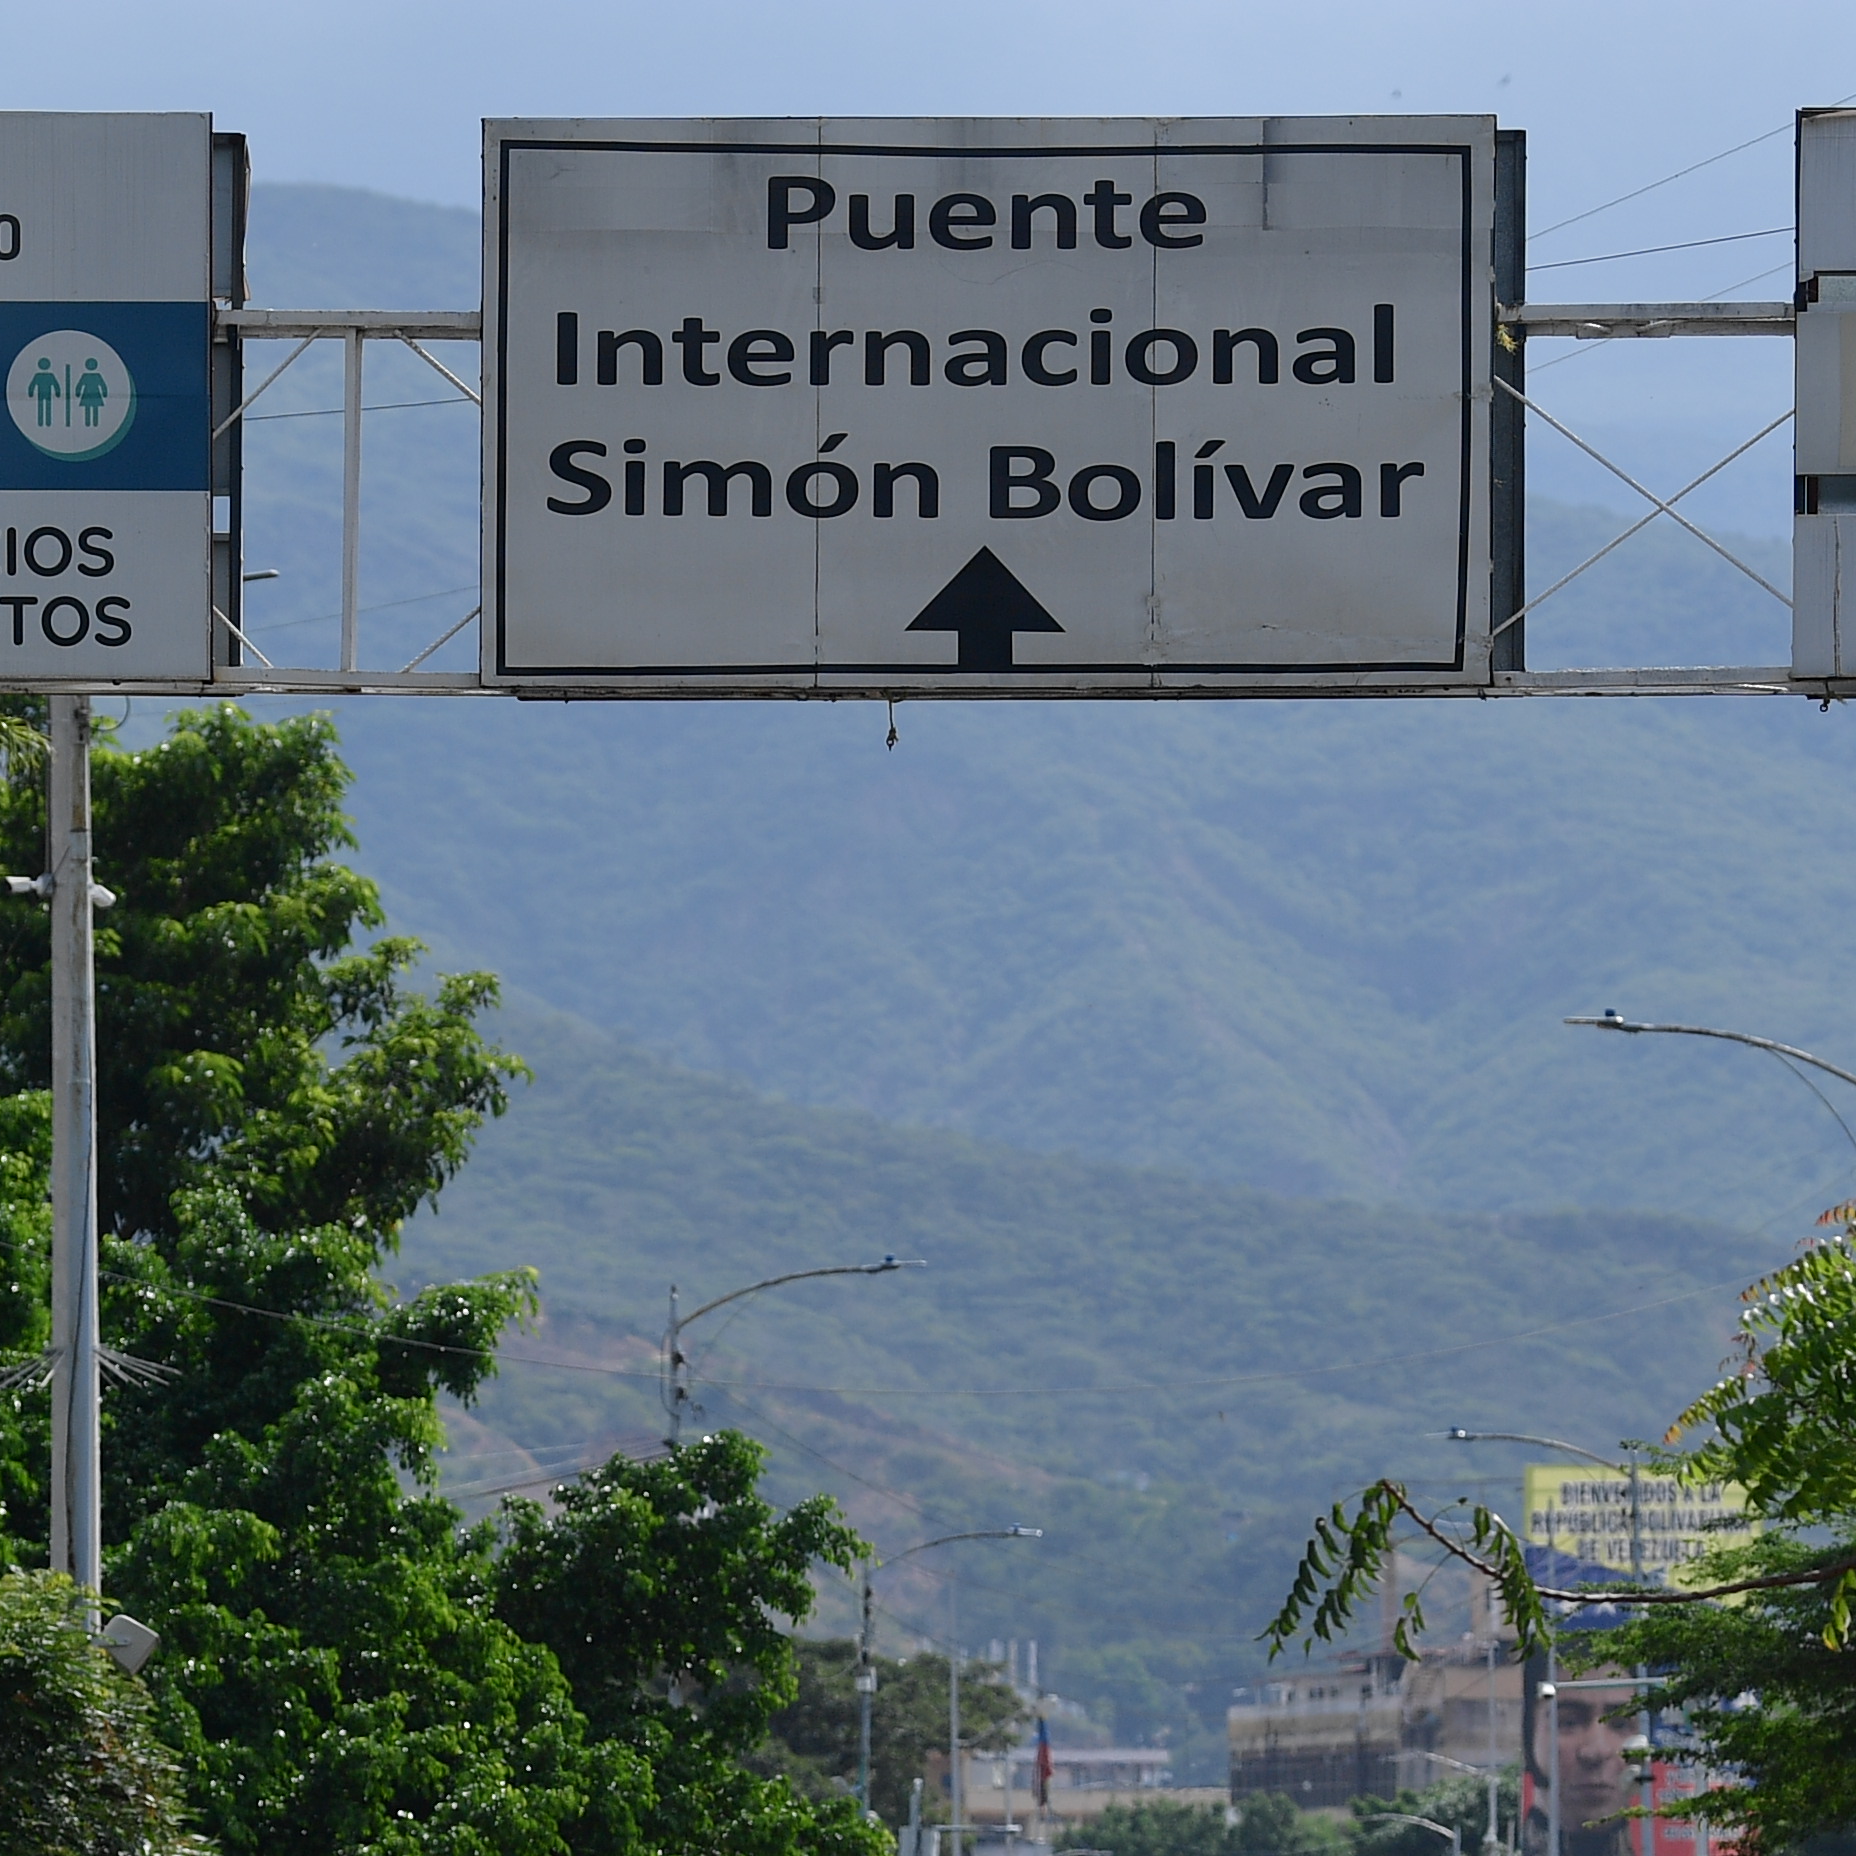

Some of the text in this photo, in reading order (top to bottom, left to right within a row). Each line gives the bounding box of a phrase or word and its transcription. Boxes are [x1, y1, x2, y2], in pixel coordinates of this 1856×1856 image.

[767, 176, 1208, 252] Puente
[556, 303, 1396, 387] Internacional
[547, 433, 1425, 521] Simón Bolívar
